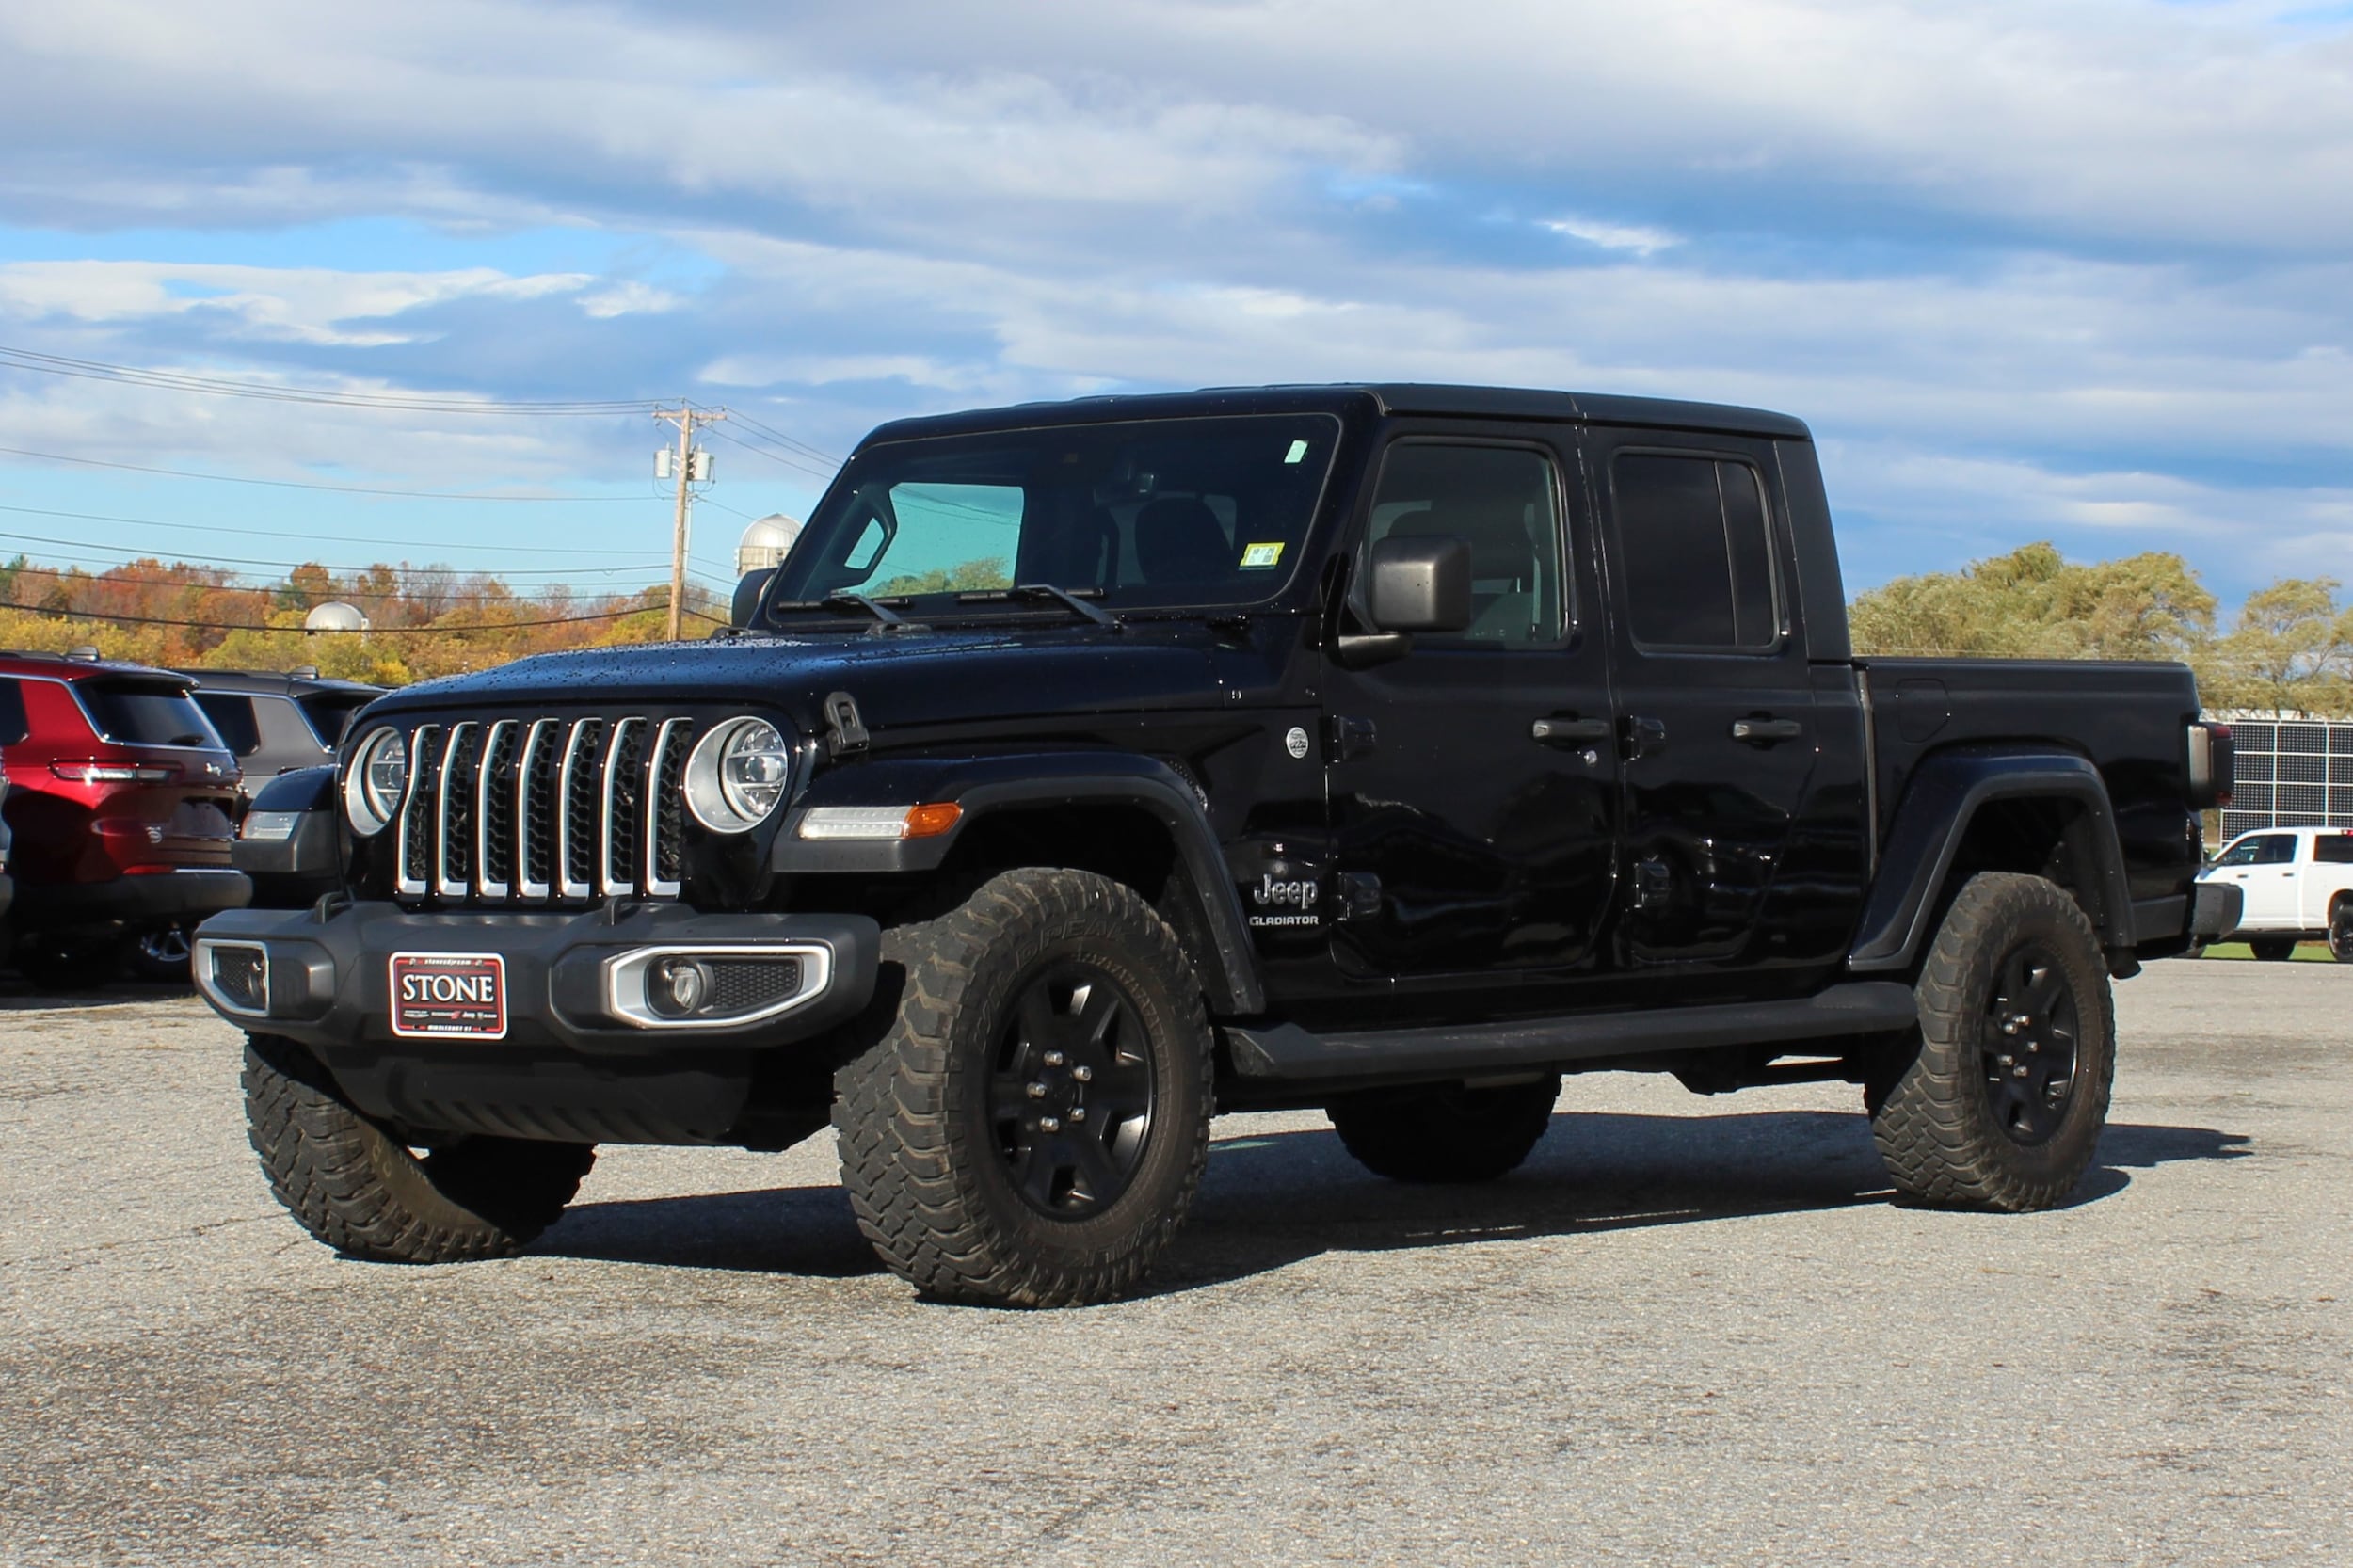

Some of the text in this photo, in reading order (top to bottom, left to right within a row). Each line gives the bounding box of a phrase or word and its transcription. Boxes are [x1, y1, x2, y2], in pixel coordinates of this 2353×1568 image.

[1254, 873, 1318, 910] Jeep
[1249, 915, 1320, 926] GLADIATOR
[403, 973, 495, 1002] STONE
